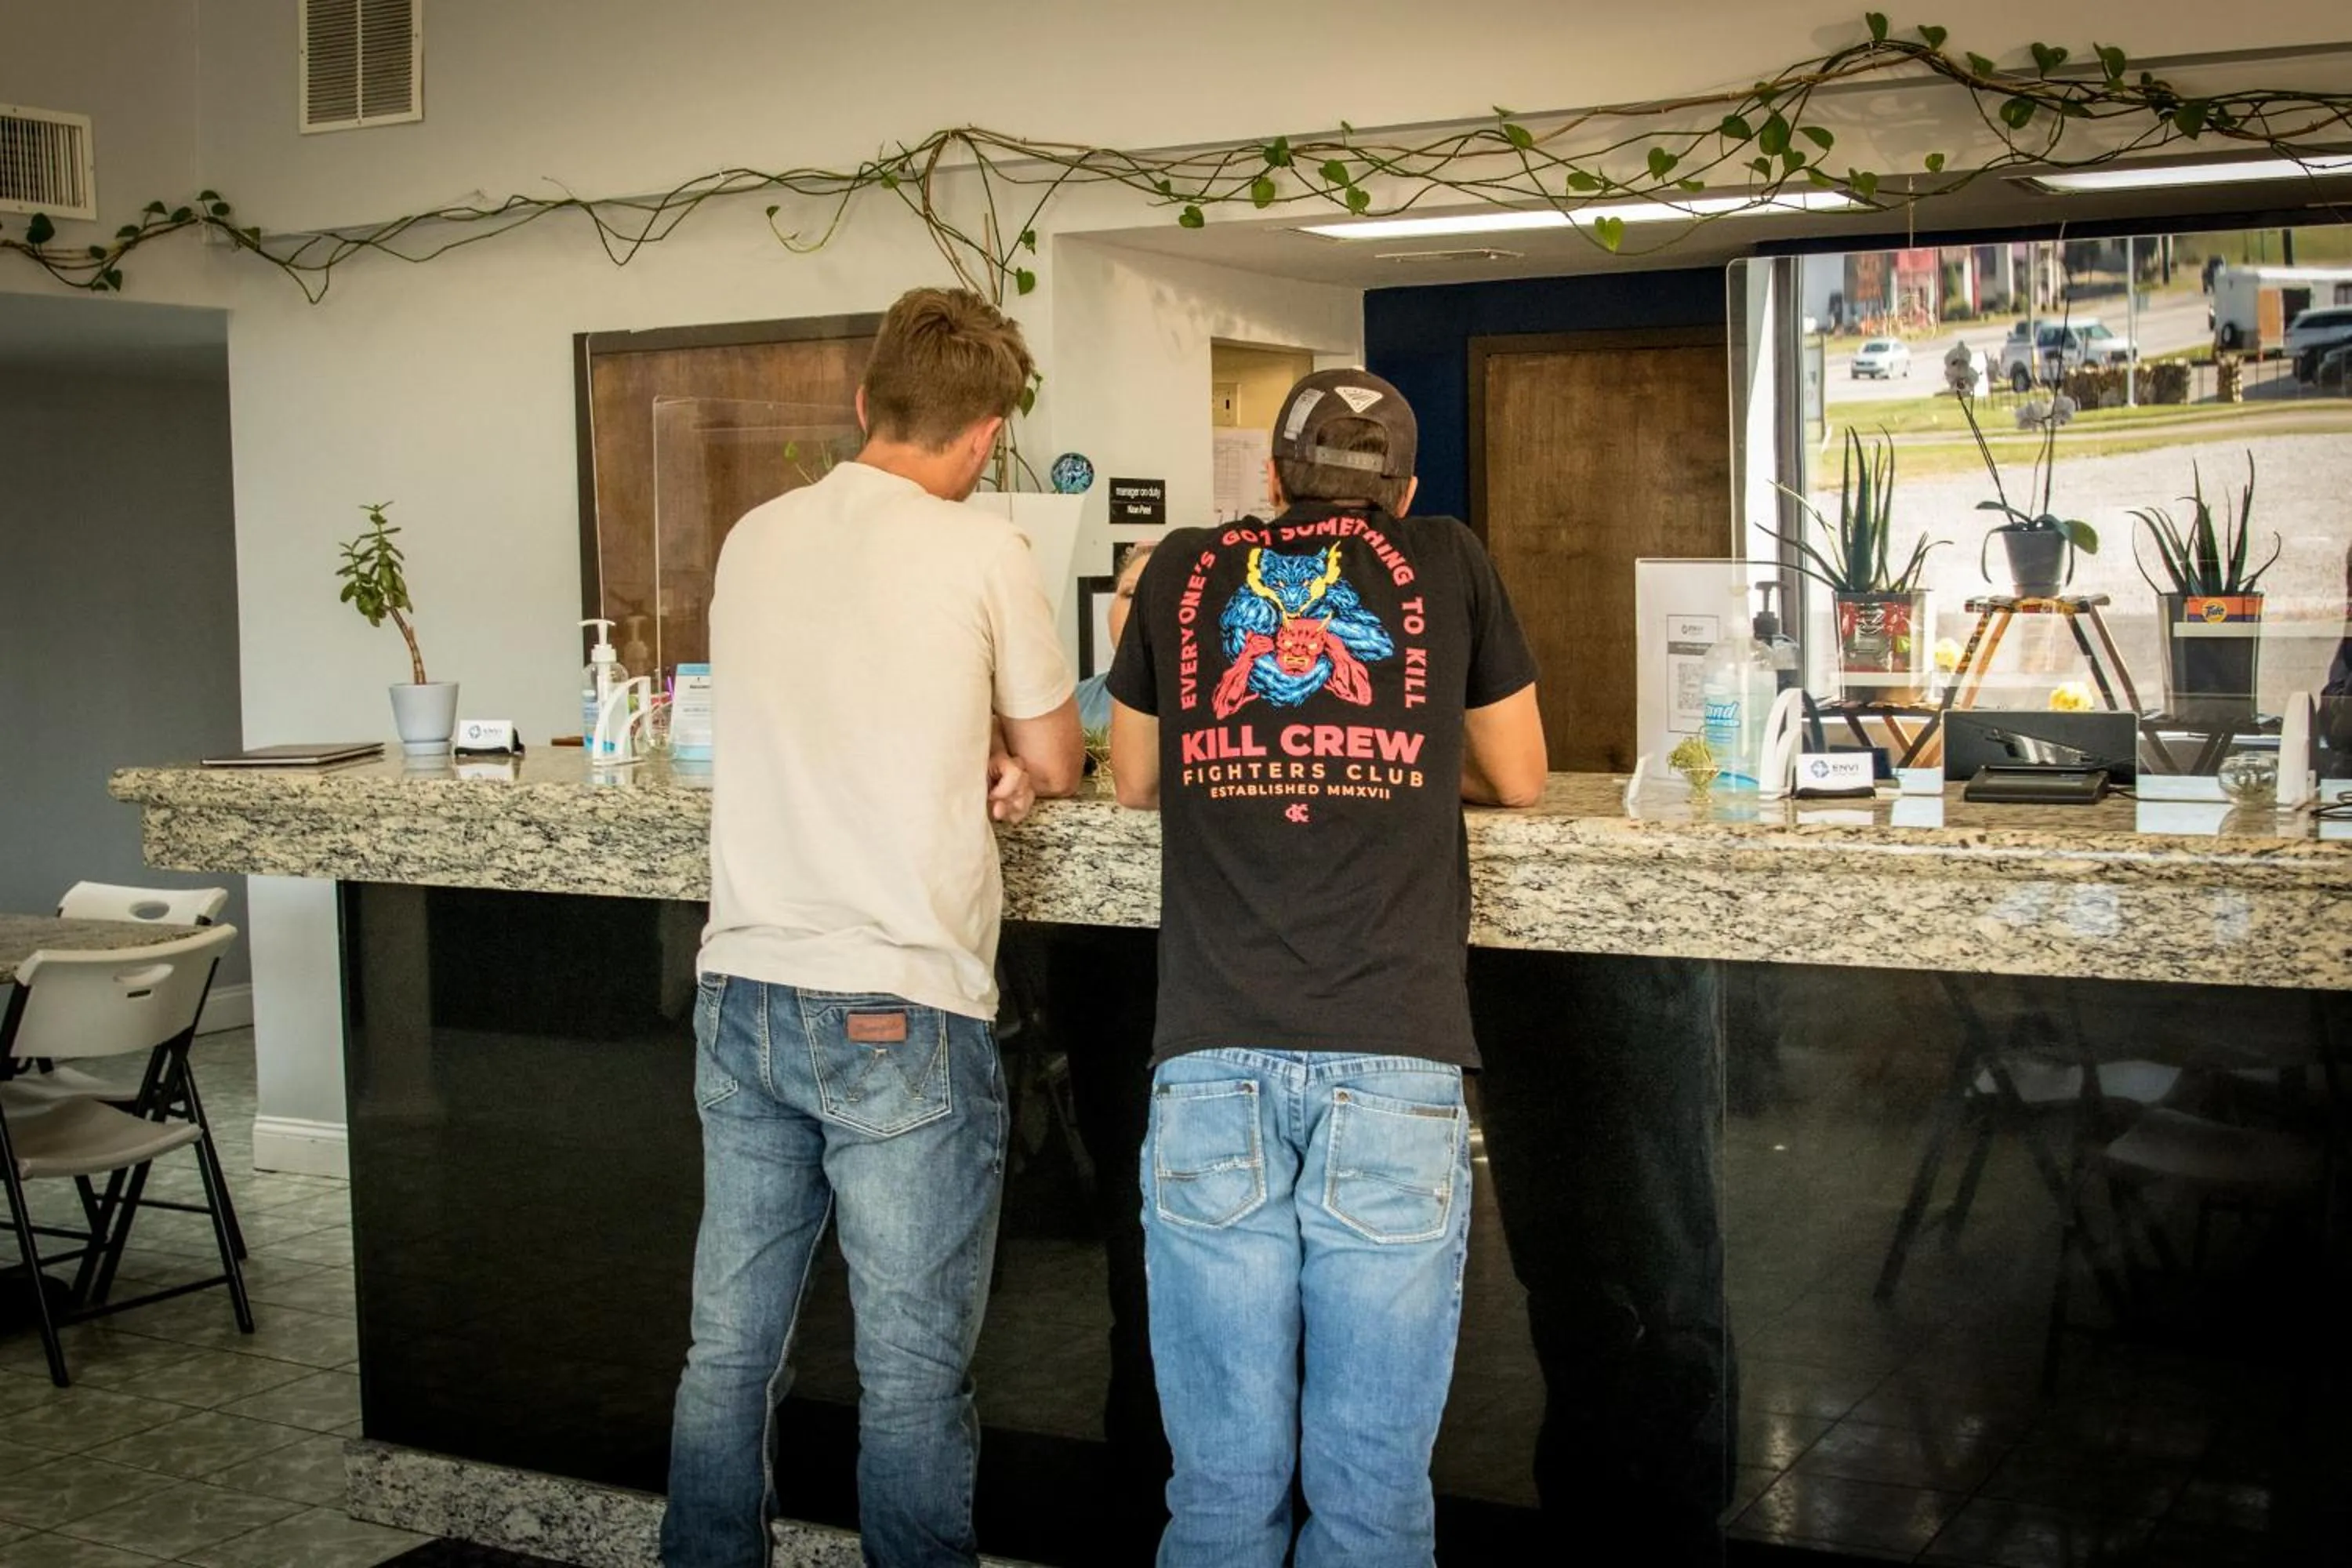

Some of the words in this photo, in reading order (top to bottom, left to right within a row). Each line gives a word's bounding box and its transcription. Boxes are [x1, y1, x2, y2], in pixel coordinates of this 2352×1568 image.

[1179, 551, 1216, 711] EVERYONE'S
[1401, 597, 1425, 635] TO
[1404, 648, 1428, 709] KILL
[1181, 724, 1268, 764] KILL
[1279, 724, 1426, 765] CREW
[1183, 762, 1326, 786] FIGHTERS
[1346, 764, 1425, 788] CLUB
[1210, 784, 1320, 799] ESTABLISHED
[1327, 785, 1391, 800] MMXVII
